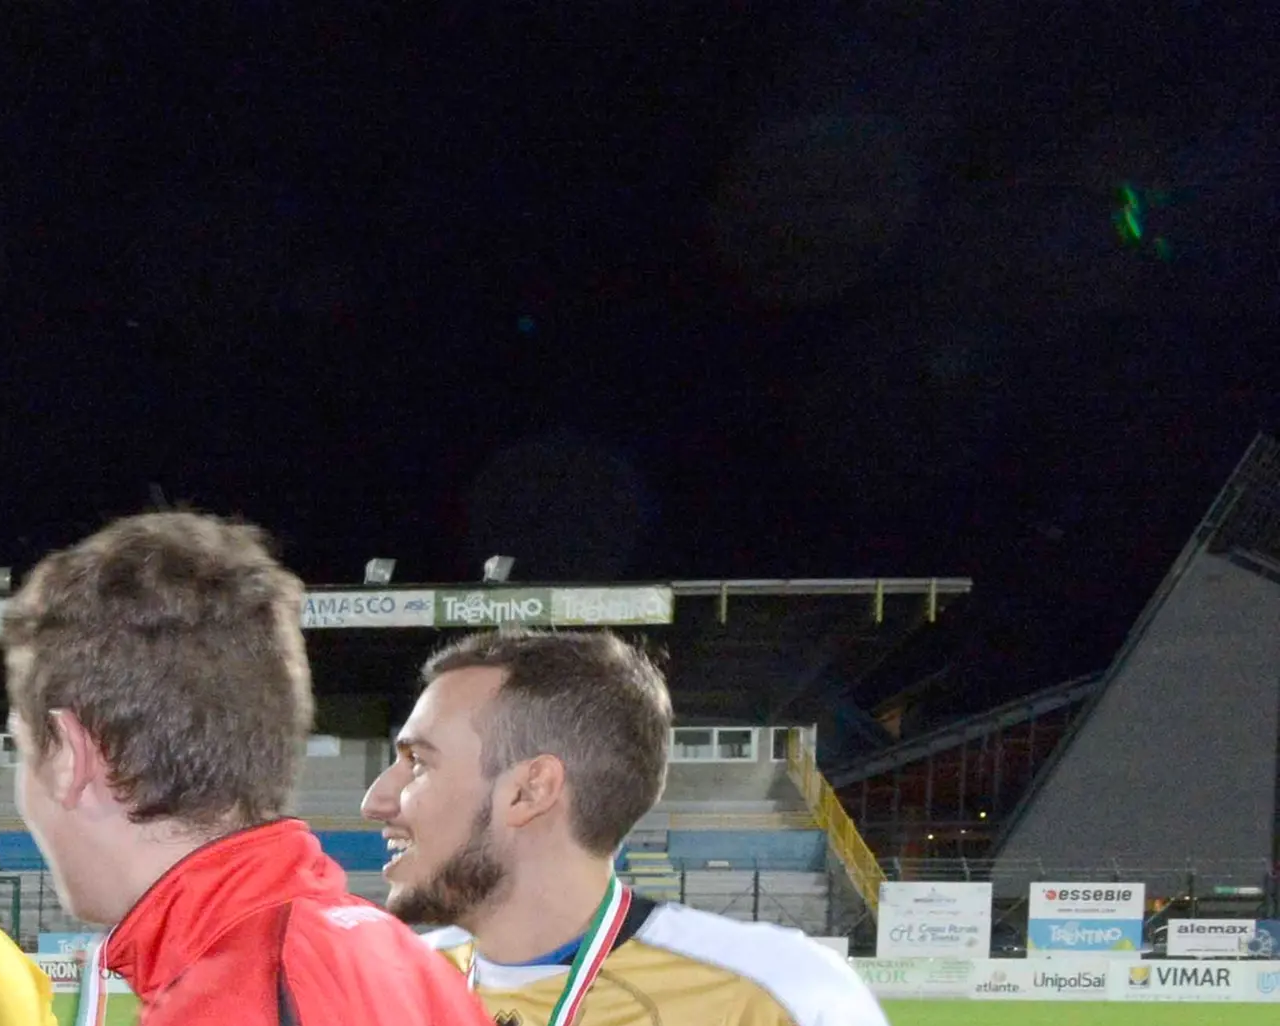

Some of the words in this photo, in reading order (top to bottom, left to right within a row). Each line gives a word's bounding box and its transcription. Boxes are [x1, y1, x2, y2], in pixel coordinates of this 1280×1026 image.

[302, 597, 395, 614] AMASCO
[442, 593, 542, 623] TRENTINO
[1177, 924, 1249, 935] alemax
[41, 962, 78, 979] TRON
[1156, 967, 1231, 987] VIMAR
[975, 982, 1020, 994] atlante
[1033, 971, 1106, 992] UnipolSai
